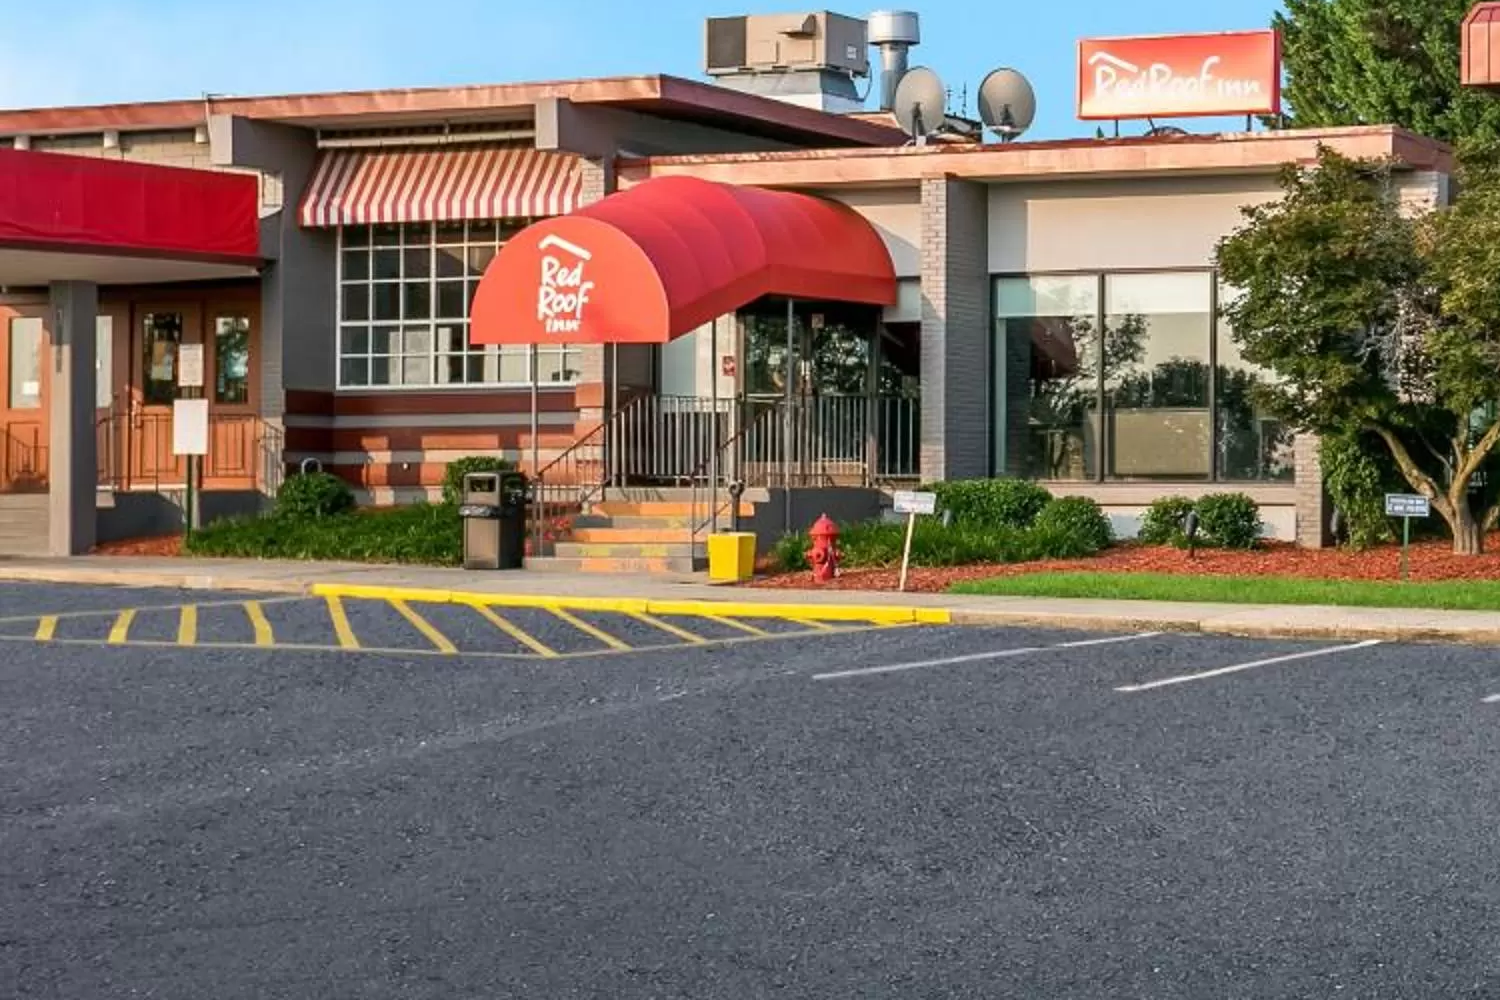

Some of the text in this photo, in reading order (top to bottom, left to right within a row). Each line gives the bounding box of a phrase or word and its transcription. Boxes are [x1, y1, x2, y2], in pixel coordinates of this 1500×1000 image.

[1096, 64, 1147, 99] Red
[1148, 56, 1219, 102] Roof
[541, 256, 583, 287] Red
[538, 281, 594, 320] Roof
